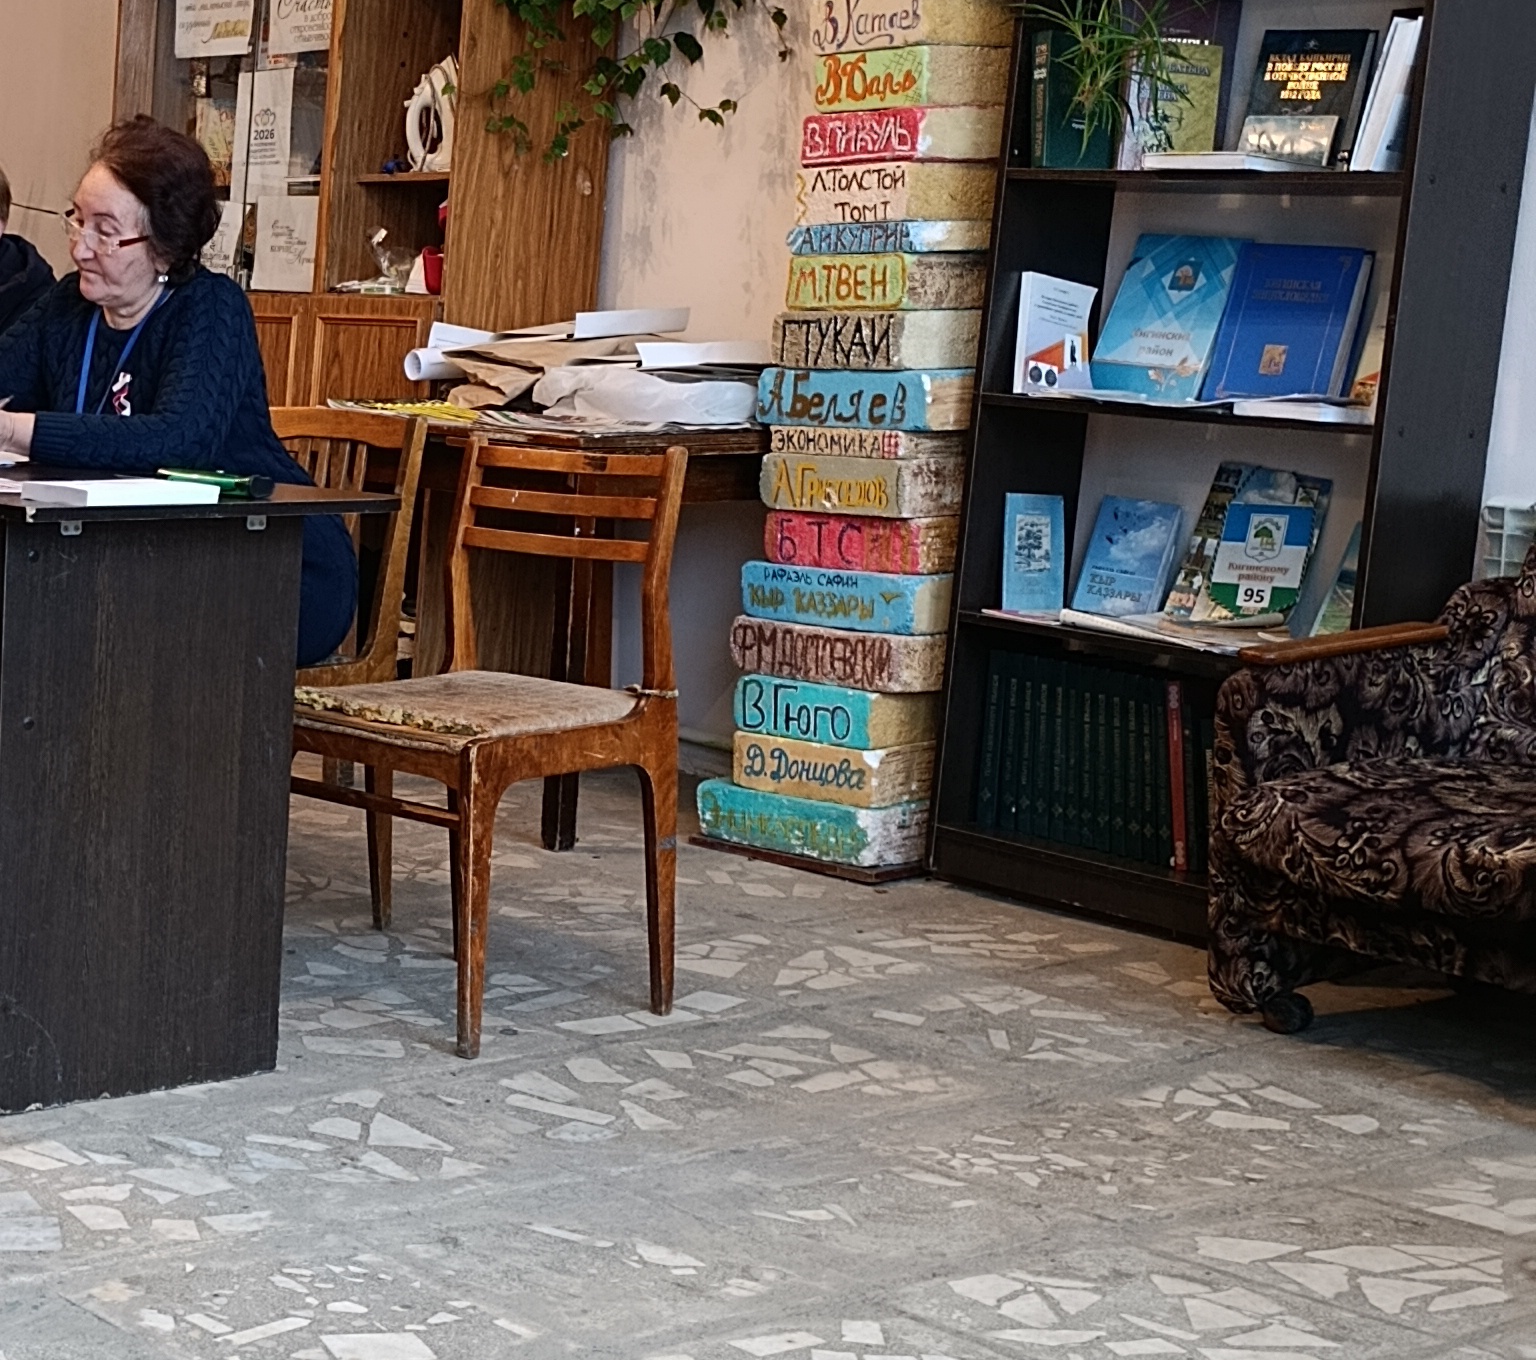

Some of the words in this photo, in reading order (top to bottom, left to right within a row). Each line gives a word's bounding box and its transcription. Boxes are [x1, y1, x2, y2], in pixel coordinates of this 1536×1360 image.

[254, 129, 275, 140] 2026
[834, 201, 877, 222] ТОМ
[795, 263, 888, 304] М.ТВЕН
[774, 429, 881, 458] ЭКОНОМИКА
[764, 567, 813, 585] РАФАЭЛЬ
[817, 574, 858, 588] САФИН
[1243, 588, 1265, 603] 95
